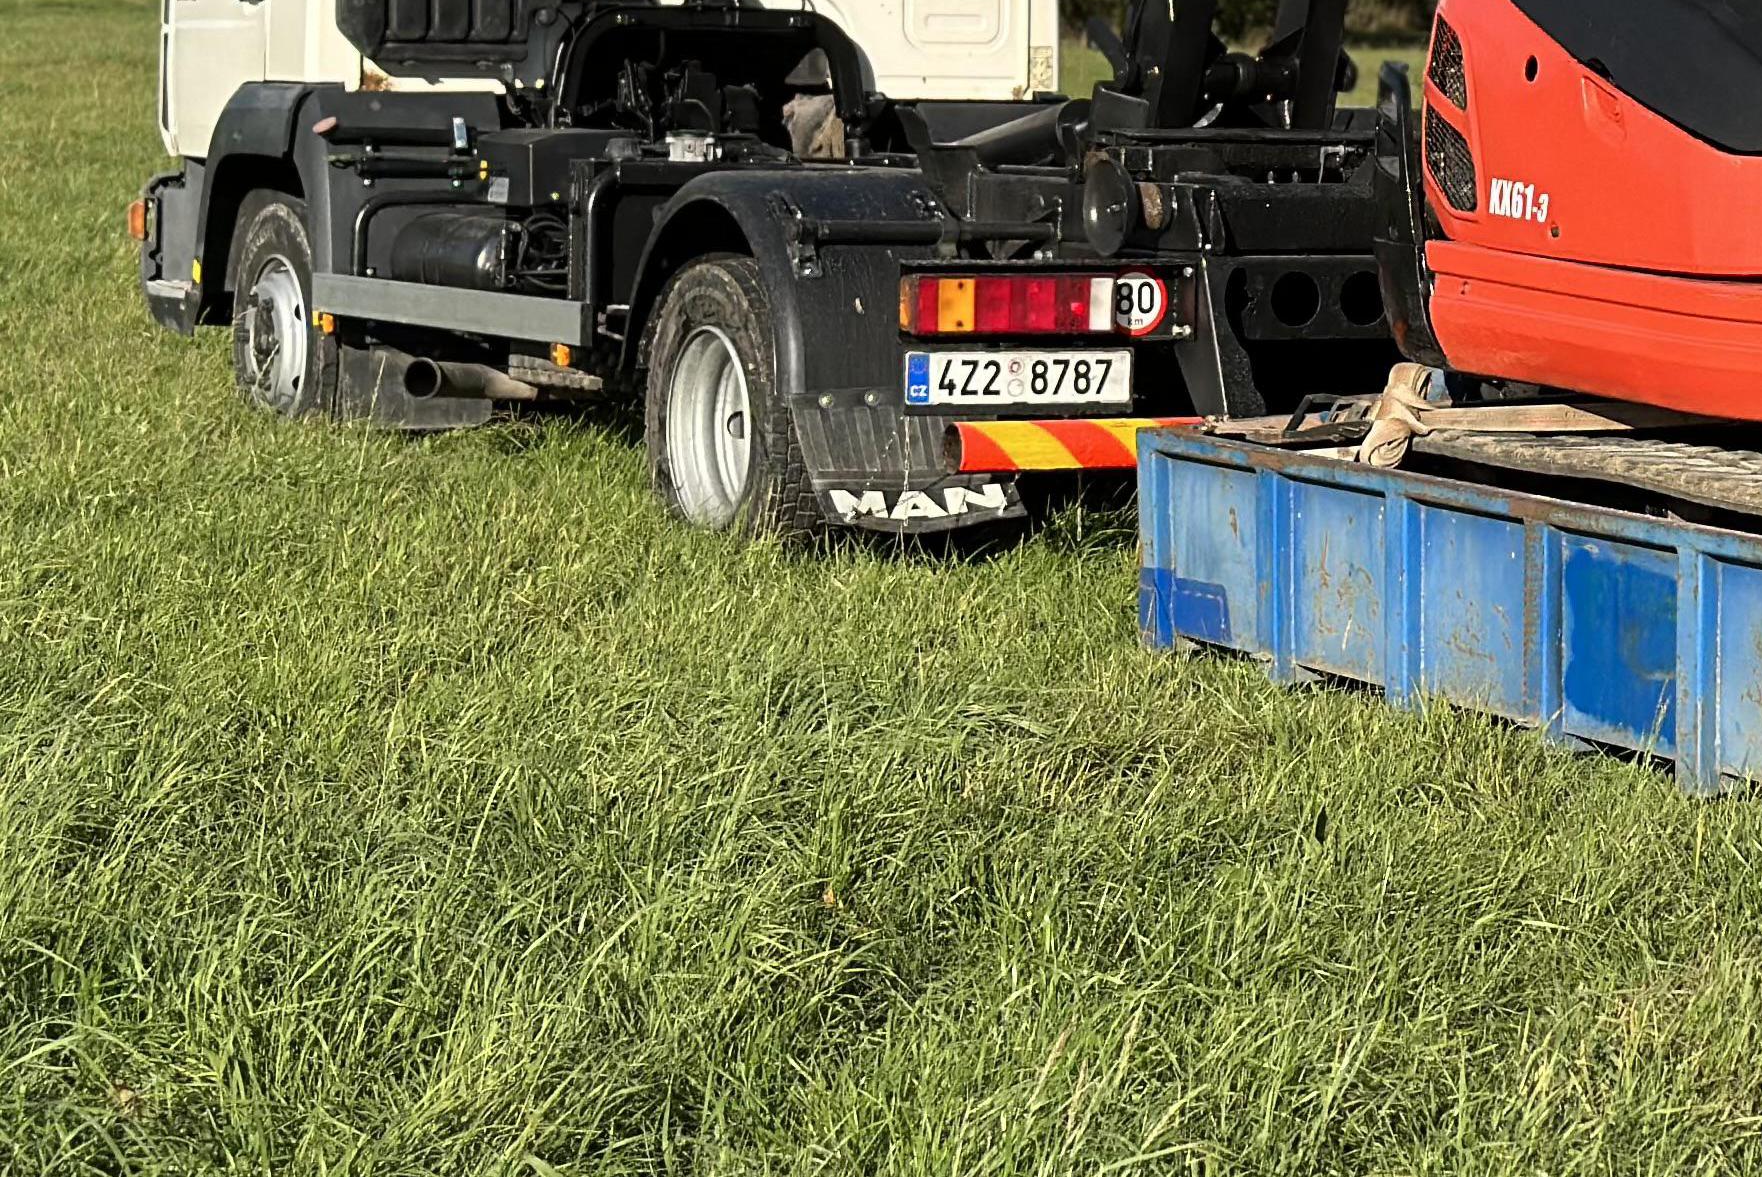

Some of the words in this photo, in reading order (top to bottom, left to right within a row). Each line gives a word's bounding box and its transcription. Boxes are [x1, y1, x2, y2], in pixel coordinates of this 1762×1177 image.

[1489, 178, 1549, 223] KX61-3
[1117, 281, 1154, 314] 80
[910, 385, 928, 397] CZ
[938, 359, 1001, 396] 4Z2
[1031, 359, 1113, 395] 8787
[829, 484, 1007, 520] MAN
